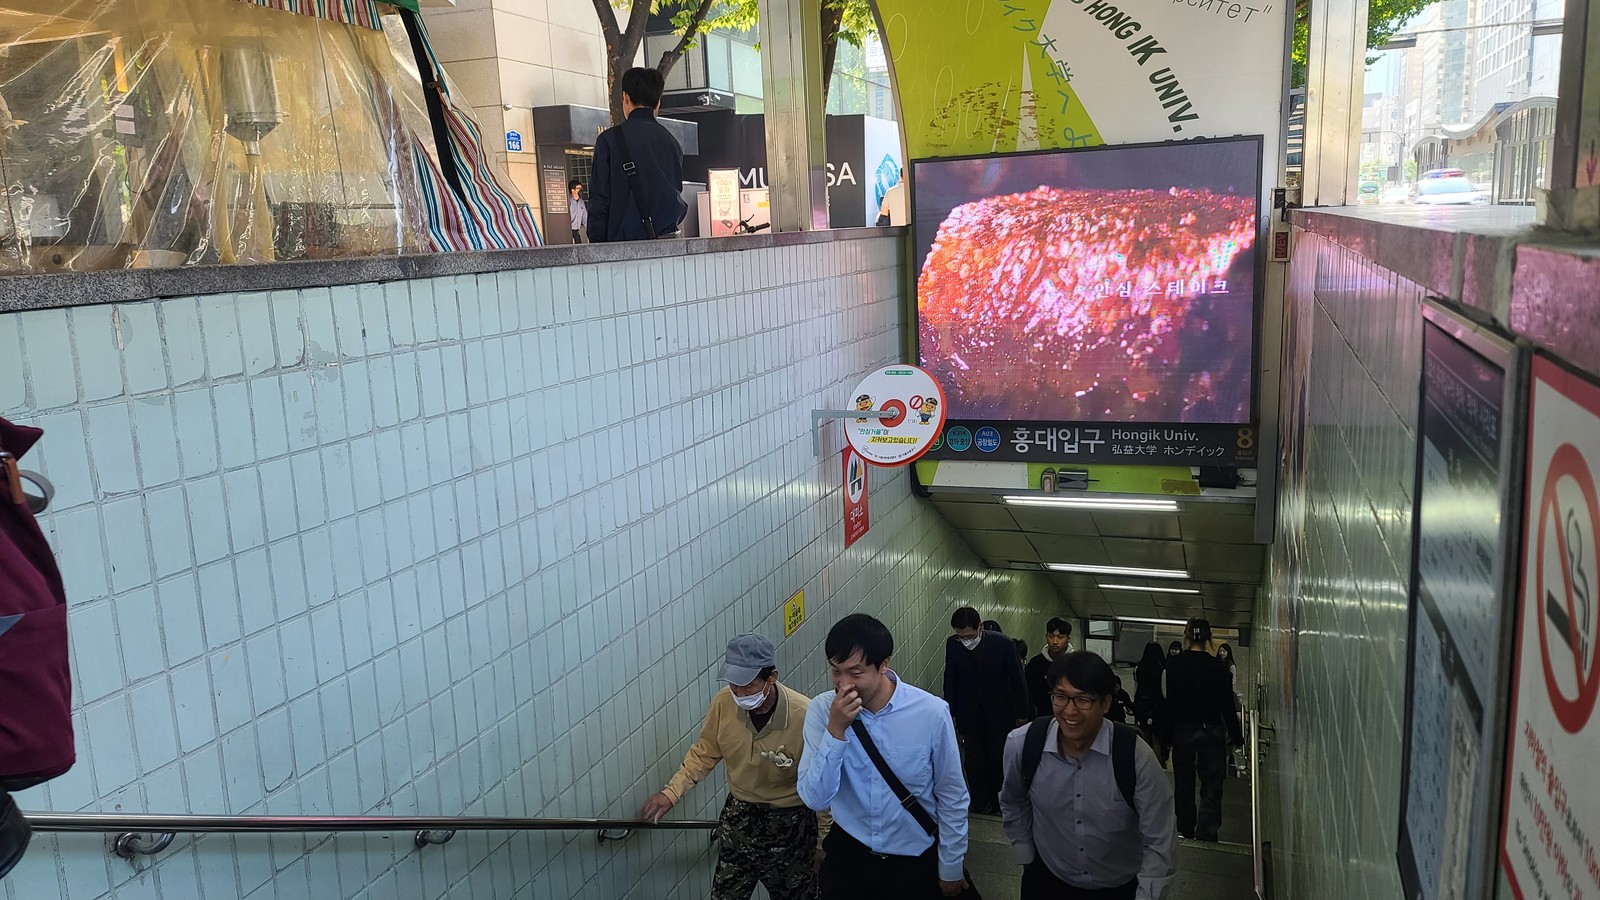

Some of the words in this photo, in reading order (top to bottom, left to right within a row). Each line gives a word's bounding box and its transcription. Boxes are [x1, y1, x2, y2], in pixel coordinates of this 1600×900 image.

[1172, 0, 1272, 23] итет"
[1083, 2, 1142, 40] HONG
[1126, 34, 1168, 66] IK
[1149, 67, 1199, 133] UNIV.
[508, 140, 520, 150] 166
[1145, 279, 1230, 296] 스테이크
[1010, 427, 1106, 454] 홍대입구
[1111, 429, 1161, 443] Hongik
[1164, 430, 1199, 441] Univ.
[1236, 428, 1254, 448] 8
[1112, 444, 1157, 455] 弘益大学
